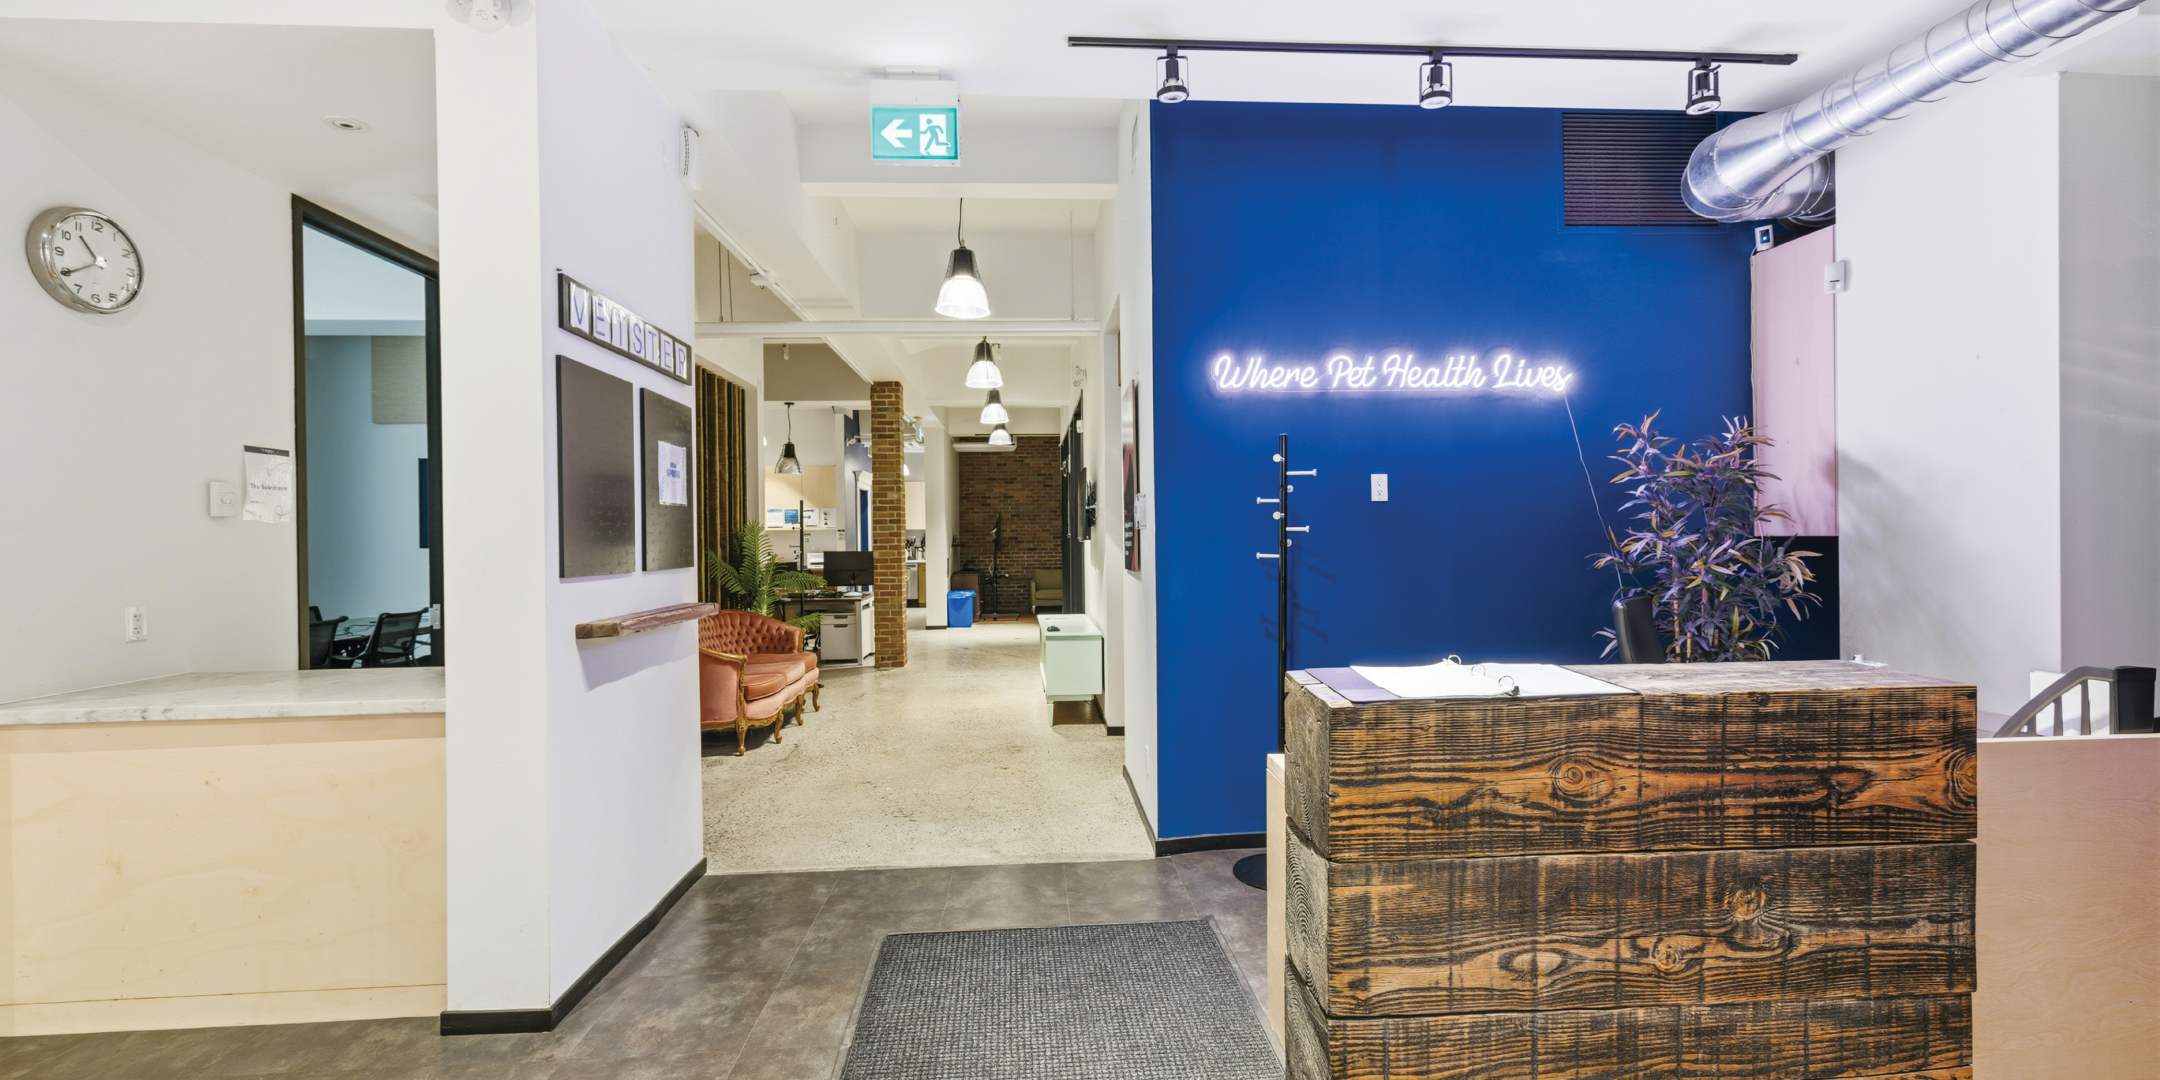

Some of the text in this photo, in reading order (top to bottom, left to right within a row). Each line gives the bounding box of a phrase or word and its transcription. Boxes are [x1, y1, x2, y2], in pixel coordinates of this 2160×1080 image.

[75, 221, 82, 232] 11
[91, 221, 104, 233] 12
[61, 229, 71, 241] 10
[54, 246, 65, 257] 9
[121, 248, 131, 259] 2
[60, 266, 71, 277] 8
[126, 267, 135, 278] 3
[74, 283, 83, 295] 7
[91, 294, 101, 303] 6
[108, 293, 118, 302] 5
[573, 285, 686, 375] VETSTER
[1213, 354, 1573, 392] Where Pet Health Lives
